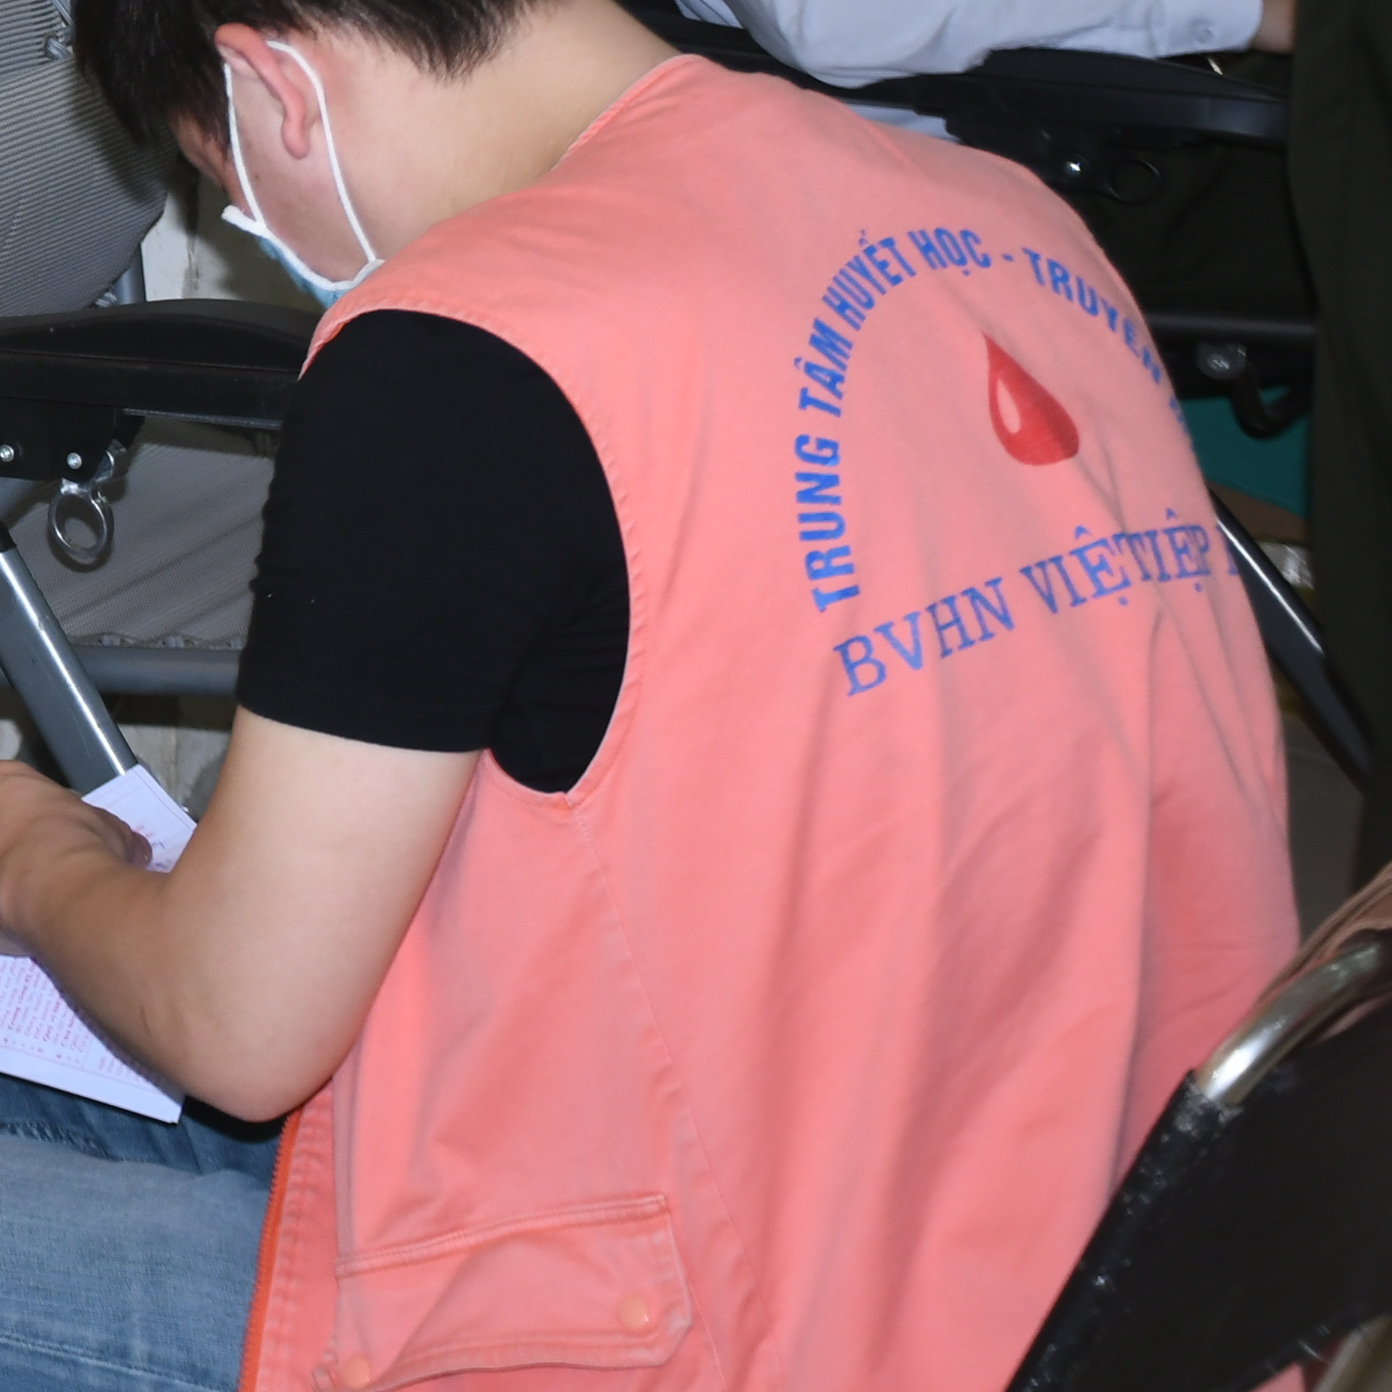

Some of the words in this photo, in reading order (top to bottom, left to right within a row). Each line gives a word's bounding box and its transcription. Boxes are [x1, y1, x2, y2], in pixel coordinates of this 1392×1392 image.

[822, 229, 917, 332] HUYẾT
[906, 227, 992, 277] HỌC
[794, 317, 854, 417] TÂM
[794, 433, 860, 613] TRUNG
[832, 578, 1016, 697] BVHN
